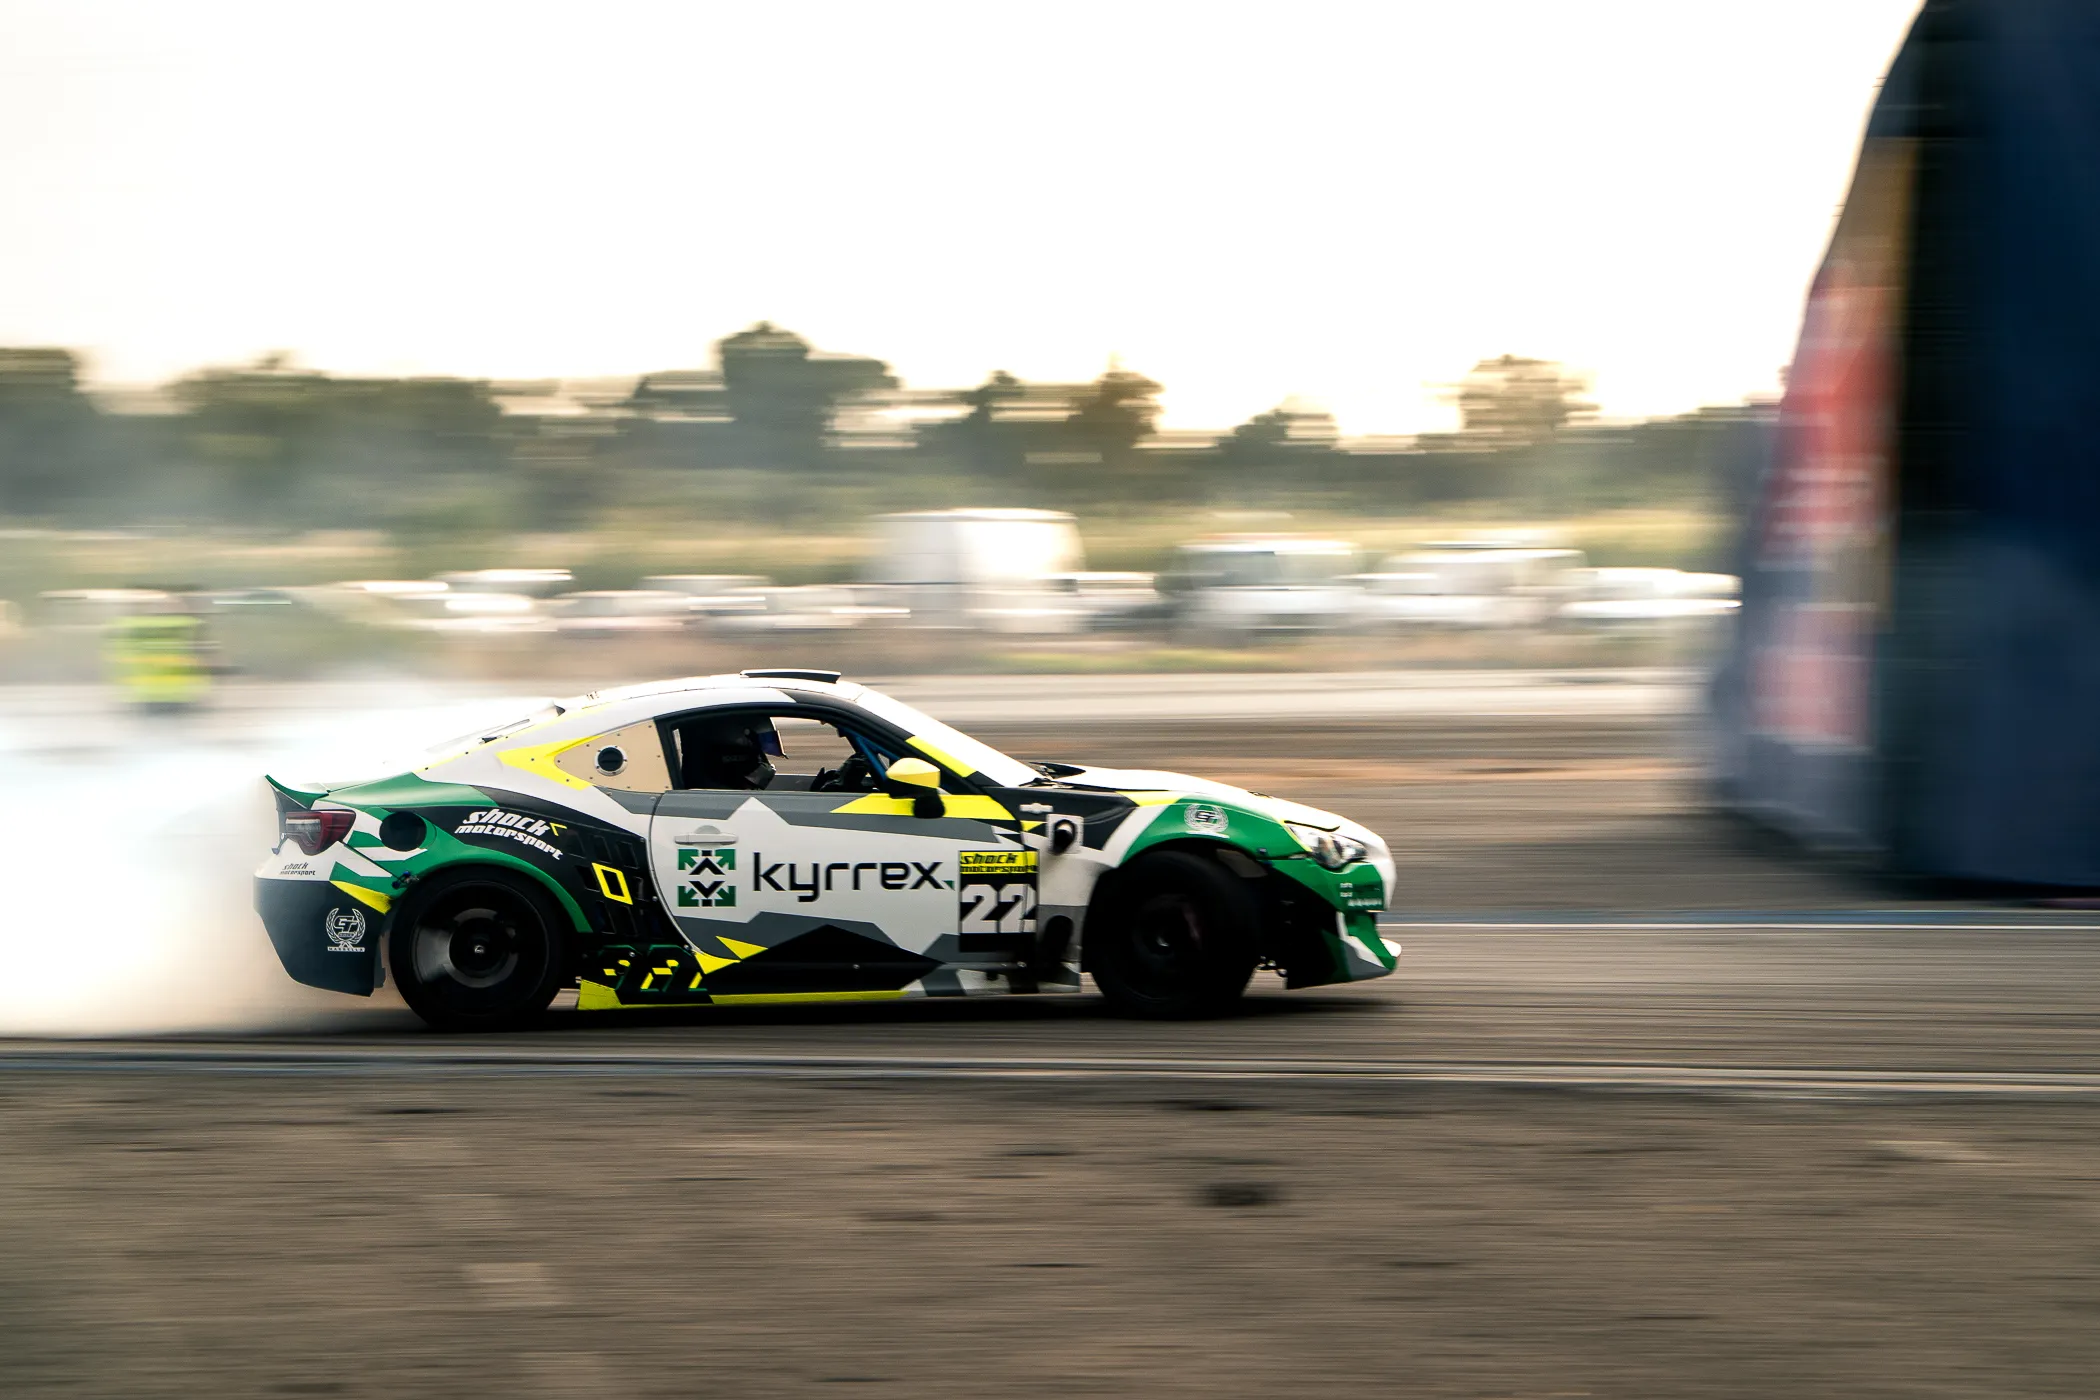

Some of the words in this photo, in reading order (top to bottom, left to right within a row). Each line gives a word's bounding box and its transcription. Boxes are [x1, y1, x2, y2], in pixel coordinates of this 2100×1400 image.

[462, 808, 551, 836] shock
[454, 824, 563, 860] motorsport
[960, 853, 1018, 865] shock
[753, 852, 944, 902] kyrrex
[960, 883, 1037, 933] 22
